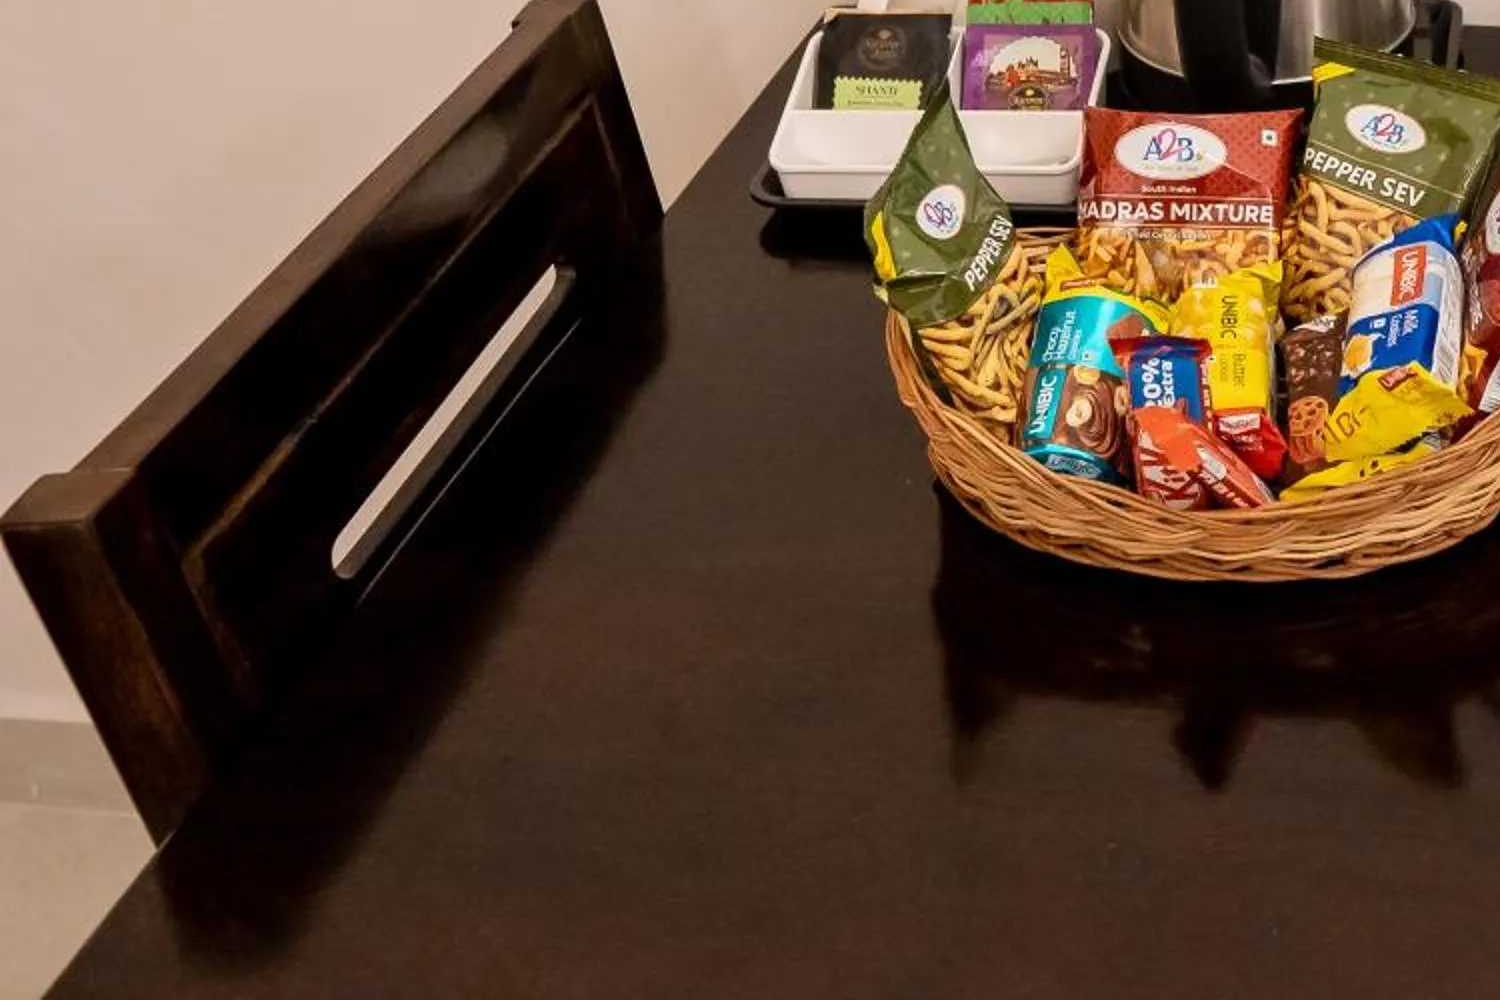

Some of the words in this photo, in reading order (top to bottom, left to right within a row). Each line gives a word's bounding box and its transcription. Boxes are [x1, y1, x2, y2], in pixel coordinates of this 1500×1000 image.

[1143, 127, 1195, 163] A2B
[1303, 147, 1377, 191] PEPPER
[1380, 176, 1426, 208] SEV
[1169, 201, 1274, 224] MIXTURE
[964, 237, 1004, 293] PEPPER
[989, 213, 1014, 241] SEV
[1220, 294, 1239, 339] UNIBIC
[1028, 375, 1058, 436] UNIBIC
